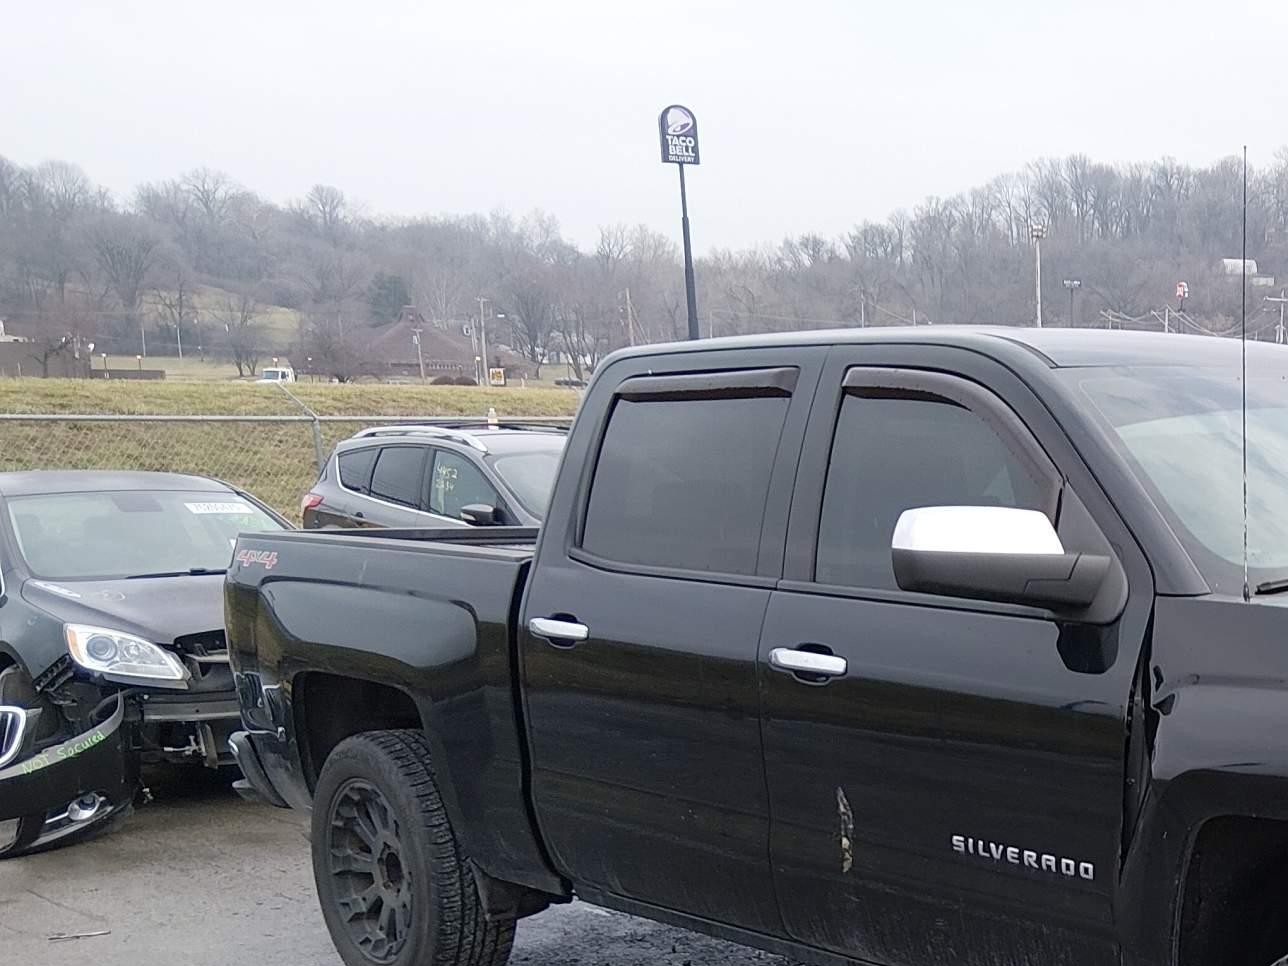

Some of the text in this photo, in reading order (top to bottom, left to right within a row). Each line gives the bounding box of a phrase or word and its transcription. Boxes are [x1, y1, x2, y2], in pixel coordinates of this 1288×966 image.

[666, 135, 695, 147] TACO
[669, 145, 696, 156] BELL
[21, 753, 49, 774] NOT
[952, 835, 1094, 880] SILVERADO
